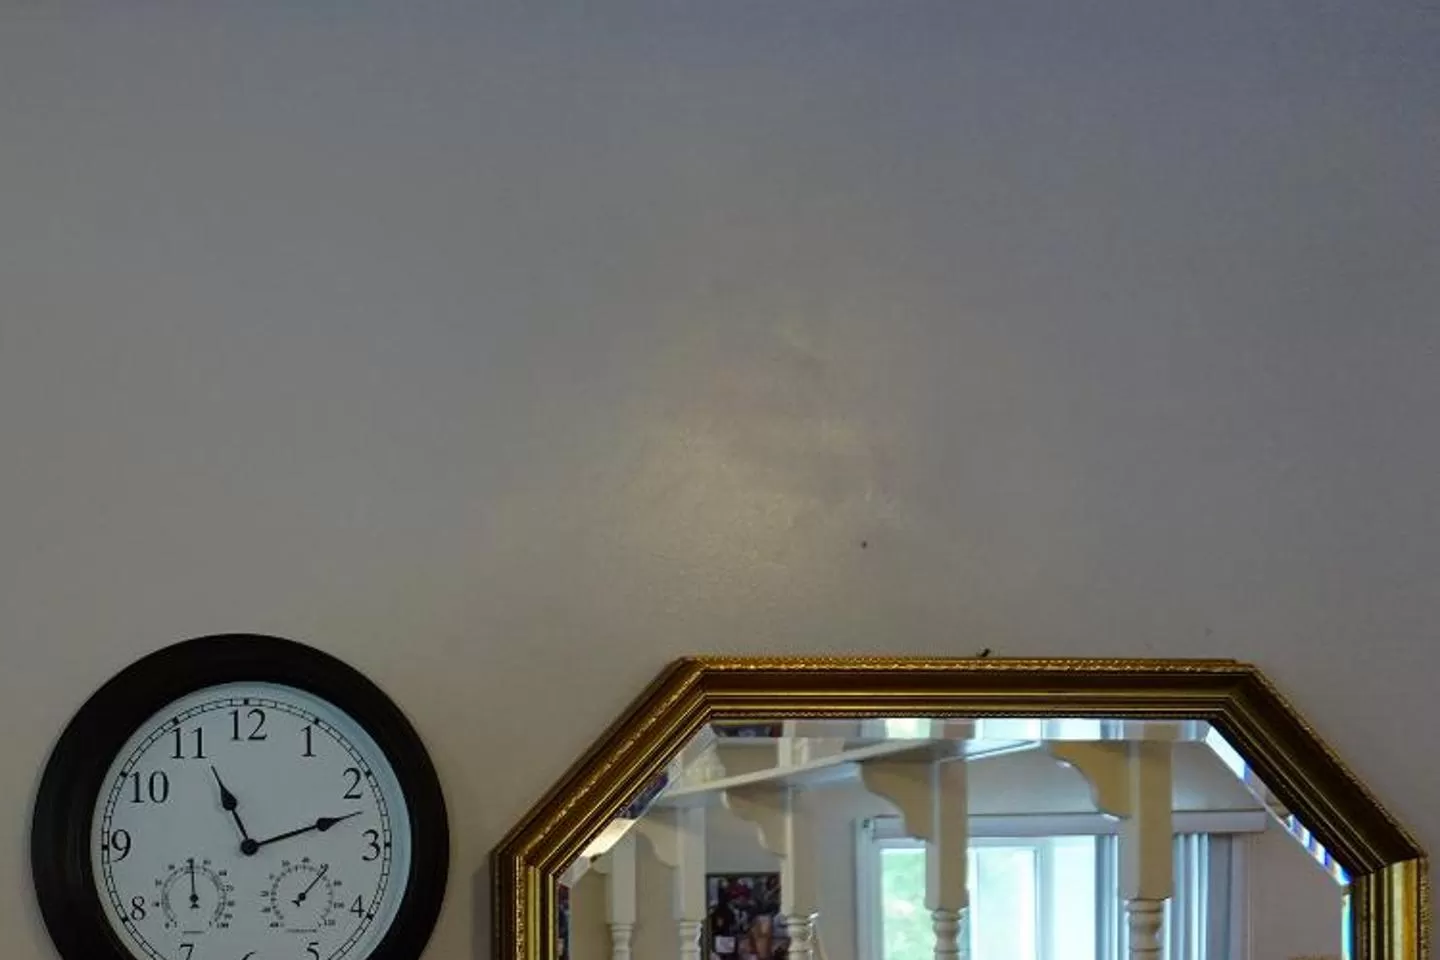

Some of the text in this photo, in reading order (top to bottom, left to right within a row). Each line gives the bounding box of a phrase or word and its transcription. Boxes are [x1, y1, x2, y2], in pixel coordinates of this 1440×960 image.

[228, 708, 268, 741] 12
[170, 727, 207, 760] 11
[300, 725, 317, 757] 1
[130, 771, 169, 804] 10
[342, 767, 362, 799] 2
[111, 829, 131, 862] 9
[362, 829, 381, 861] 3
[131, 895, 146, 921] 8
[350, 894, 365, 918] 4
